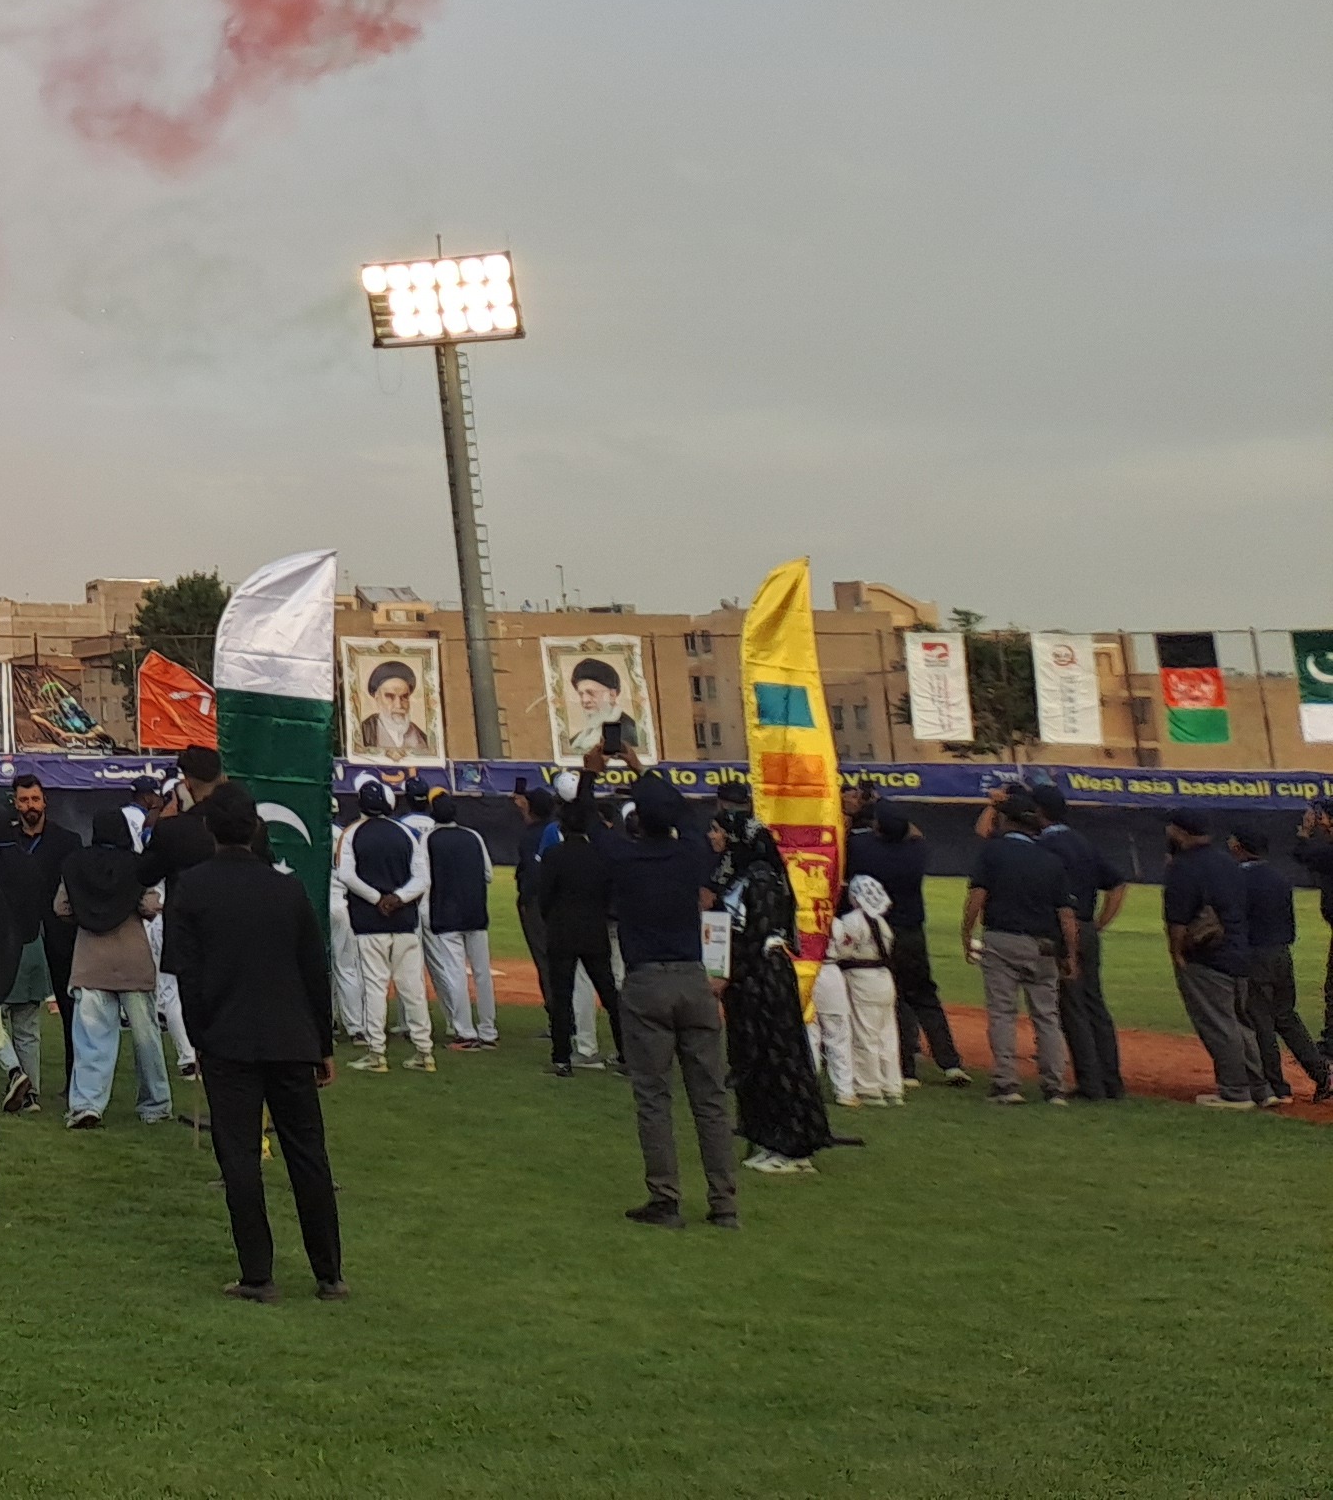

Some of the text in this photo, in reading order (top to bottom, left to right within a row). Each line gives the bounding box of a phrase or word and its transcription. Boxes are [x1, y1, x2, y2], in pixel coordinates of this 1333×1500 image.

[668, 767, 697, 786] to
[1067, 772, 1124, 792] West
[1128, 779, 1174, 795] asia
[1176, 778, 1272, 797] baseball
[1276, 783, 1320, 800] cup
